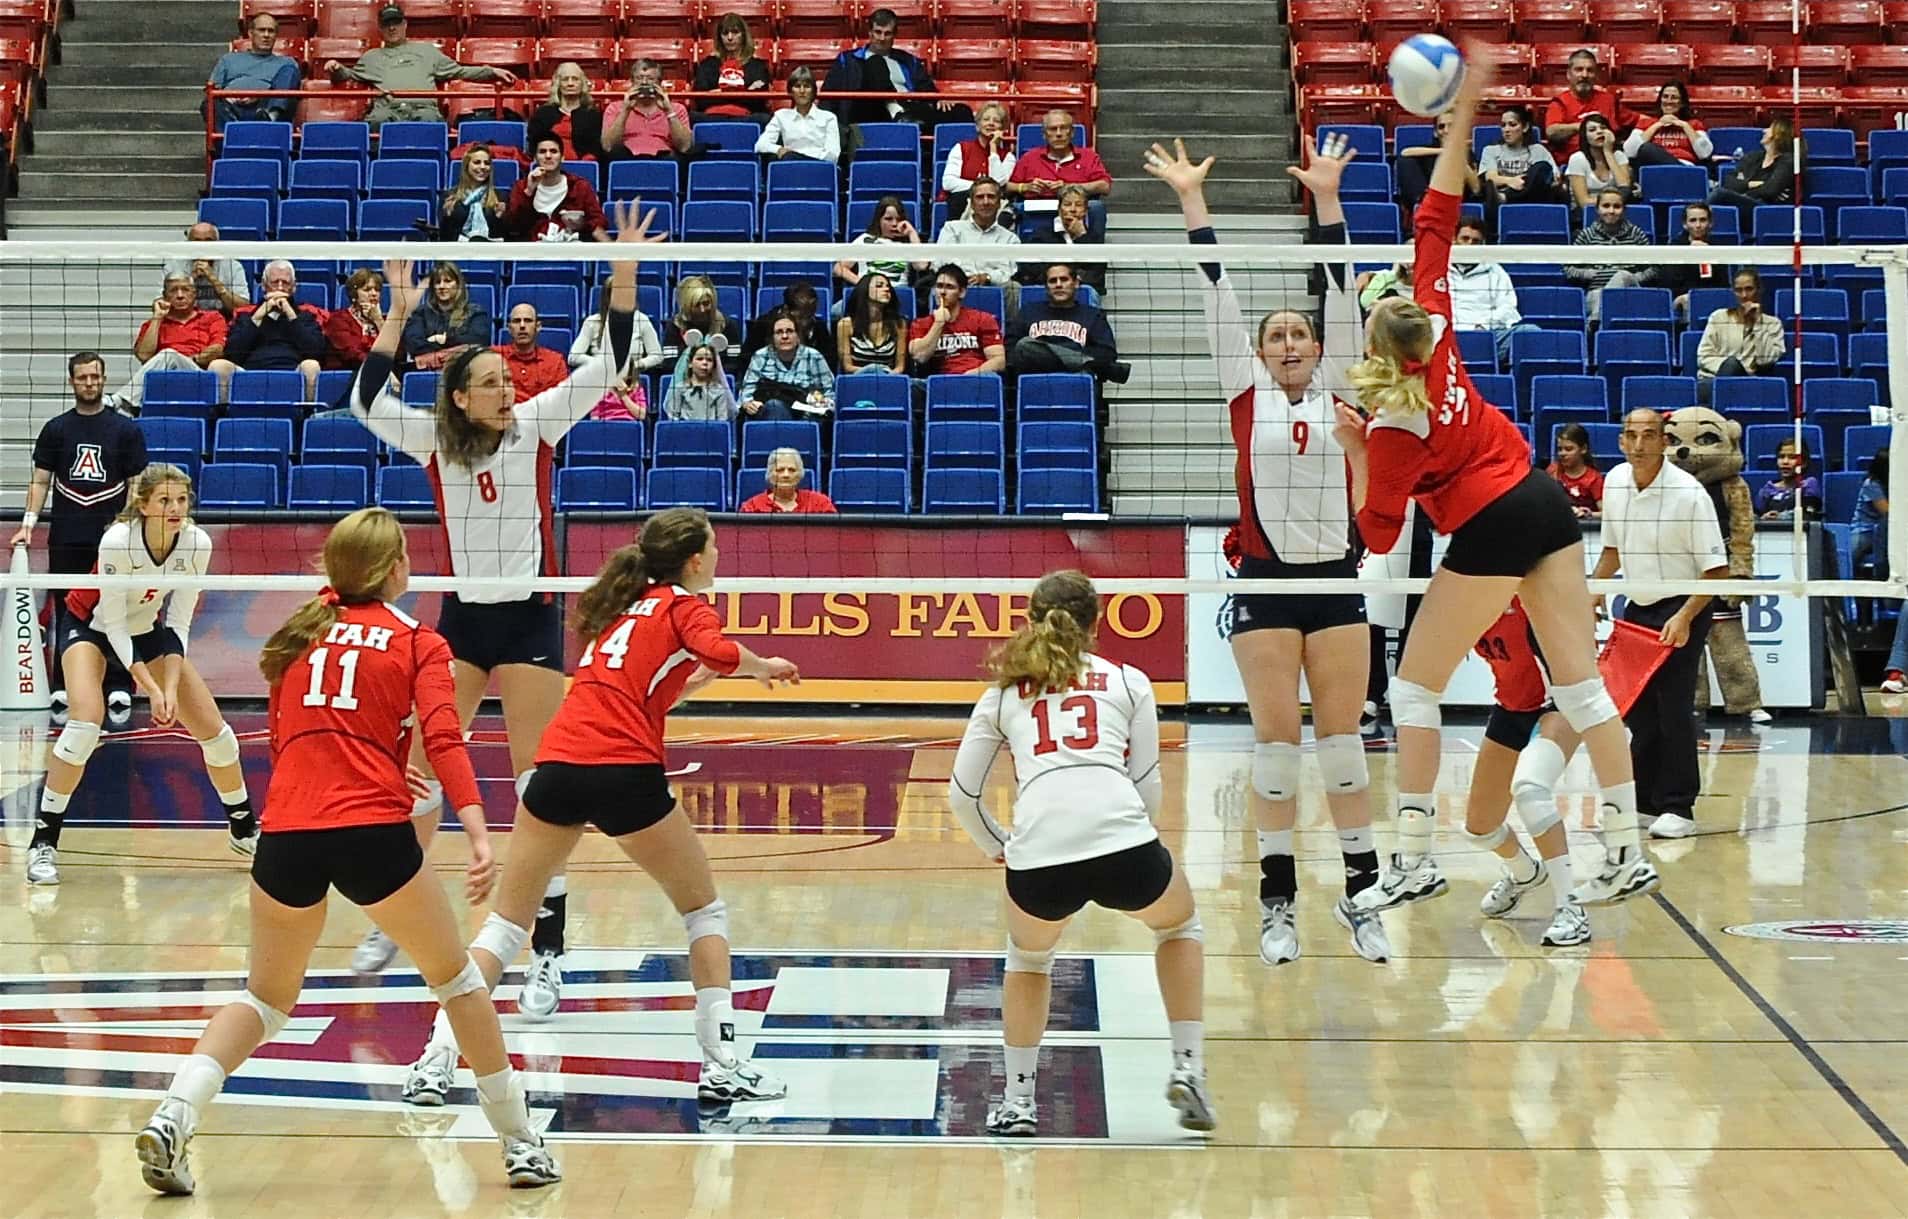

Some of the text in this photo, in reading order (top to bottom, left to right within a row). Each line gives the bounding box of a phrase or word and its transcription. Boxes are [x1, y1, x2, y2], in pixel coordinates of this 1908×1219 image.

[1293, 421, 1309, 455] 9
[70, 444, 106, 482] A
[477, 471, 497, 503] 8
[891, 592, 1163, 638] FARO
[325, 622, 394, 652] TAH
[303, 647, 360, 710] 11
[1031, 695, 1099, 756] 13
